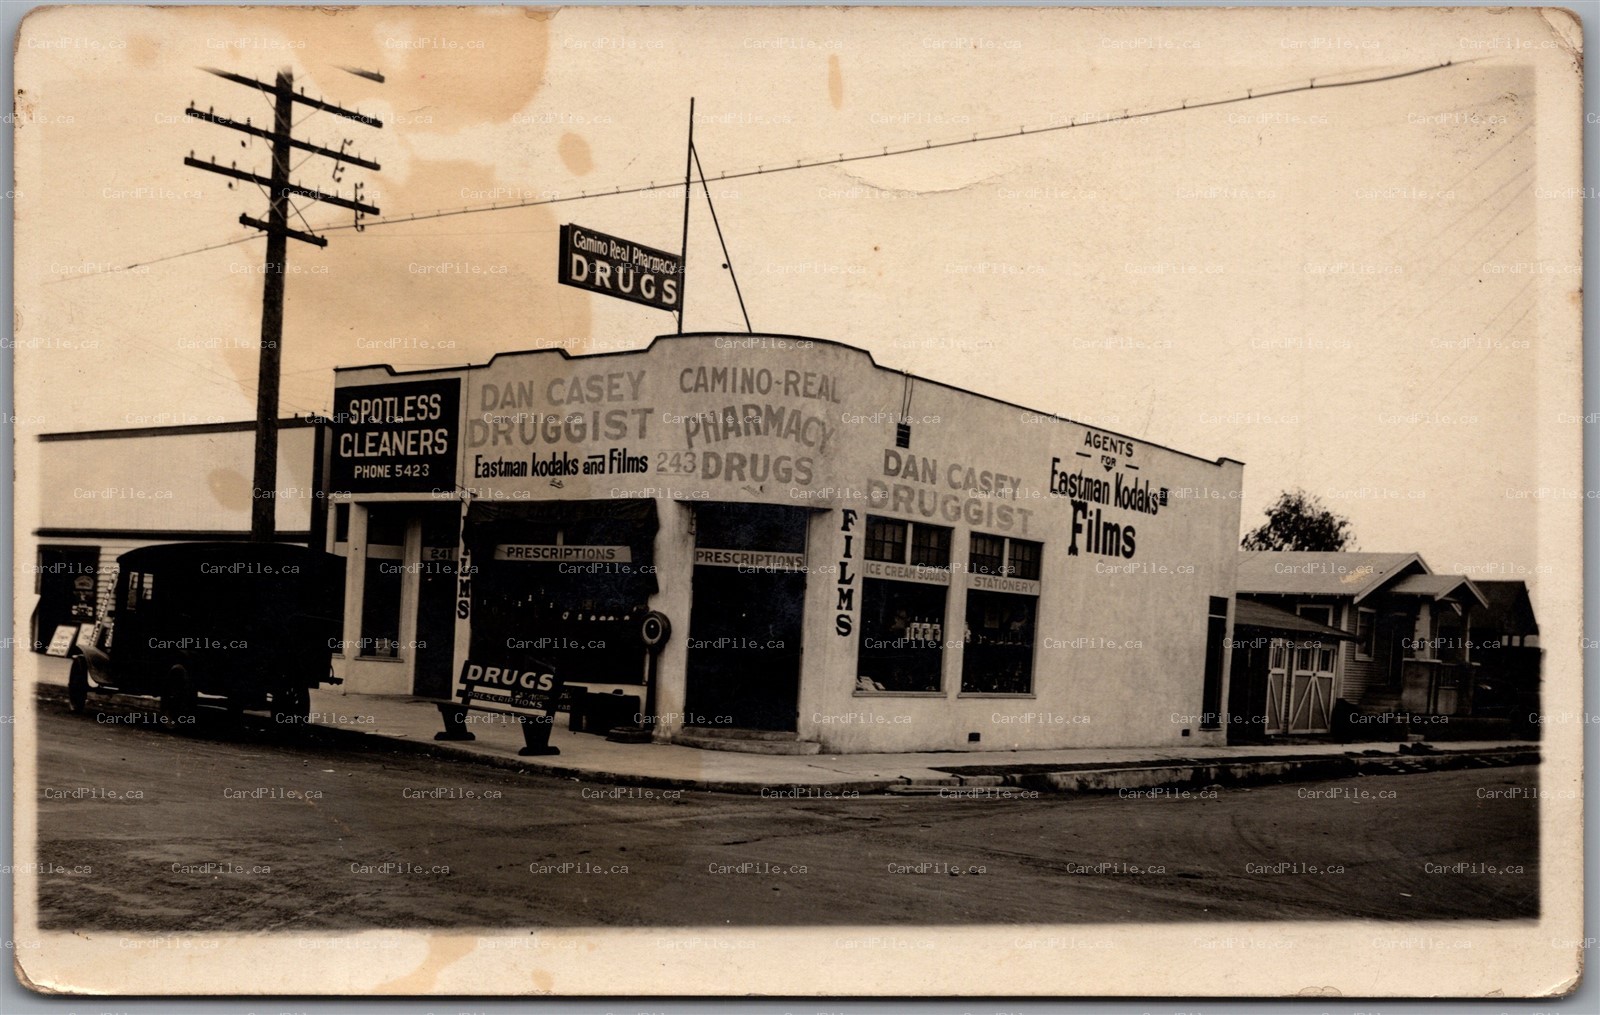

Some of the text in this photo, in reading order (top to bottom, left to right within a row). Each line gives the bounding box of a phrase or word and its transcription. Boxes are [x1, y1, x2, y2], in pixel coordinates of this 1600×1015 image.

[573, 230, 678, 275] Camino Real Pharmacy
[571, 253, 677, 305] DRUGS
[481, 370, 646, 411] DAN CASEY
[349, 393, 442, 425] SPOTLESS
[340, 428, 448, 457] CLEANERS
[468, 408, 654, 448] DRUGGIST
[684, 403, 836, 454] PHARMACY
[1084, 431, 1133, 457] AGENTS
[354, 464, 430, 478] PHONE 5423
[474, 454, 527, 478] Eastman
[583, 454, 605, 474] and
[609, 448, 648, 474] Films
[656, 451, 696, 475] 243
[701, 451, 814, 485] DRUGS
[884, 449, 1021, 501] DAN CASEY
[1101, 455, 1117, 466] FOR
[1050, 457, 1110, 505] Eastman
[1114, 472, 1158, 515] Kodaks
[865, 478, 1033, 535] DRUGGIST
[1068, 499, 1136, 559] Films
[430, 548, 453, 560] 241
[507, 546, 615, 560] PRESCRIPTIONS
[695, 551, 803, 567] PRESCRIPTIONS
[836, 508, 858, 637] FILMS
[866, 563, 881, 575] ICE
[884, 565, 915, 578] CREAM
[974, 576, 1035, 593] STATIONERY
[467, 664, 554, 691] DRUGS
[468, 691, 543, 708] PRESCRIPTIONS
